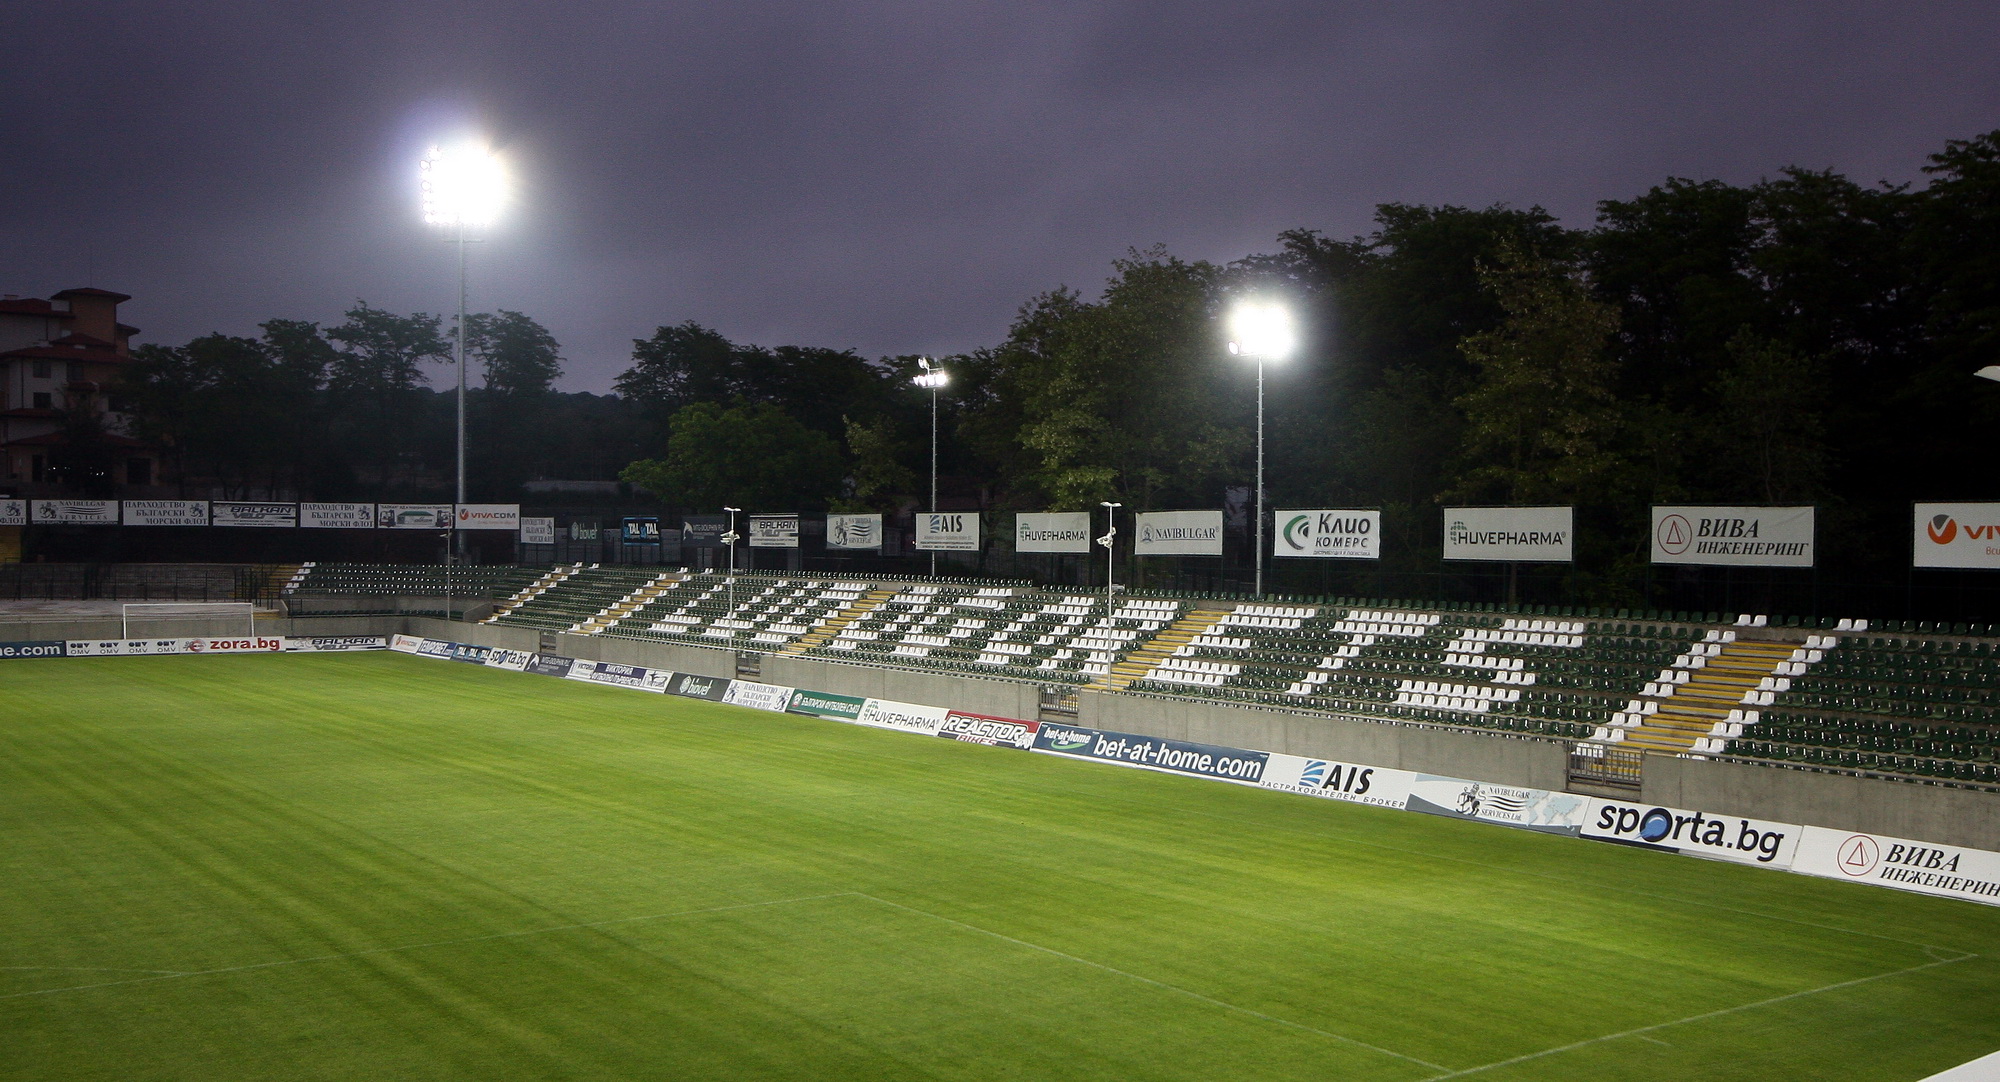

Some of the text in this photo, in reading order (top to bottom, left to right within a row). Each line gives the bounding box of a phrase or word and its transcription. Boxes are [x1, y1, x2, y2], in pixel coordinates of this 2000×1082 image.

[302, 503, 355, 511] ПАРАХОДСТВО
[311, 511, 354, 519] БЪЛГАРСКИ
[759, 521, 796, 529] BALKAN
[941, 515, 963, 533] AIS
[1317, 513, 1371, 534] Клио
[1697, 518, 1759, 538] ВИВА
[1963, 525, 2000, 540] VI
[1024, 530, 1085, 541] HUVEPHARMA
[1155, 527, 1216, 540] NAVIBULGAR
[1315, 537, 1369, 548] КОМЕРС
[1458, 531, 1563, 545] HUVEPHARMA
[1696, 541, 1809, 556] ИНЖЕНЕРИНГ
[209, 637, 280, 652] zora.bg
[490, 649, 527, 668] sporta.bg
[687, 677, 713, 696] biovet
[868, 709, 936, 731] HUVEPHARMA
[940, 715, 1026, 742] REACTOR
[956, 735, 998, 746] BIKES
[1044, 726, 1092, 744] bet-at-home
[1093, 735, 1262, 780] bet-at-home.com
[1322, 764, 1375, 795] AIS
[1260, 780, 1406, 809] ЗАСТРАХОВАТЕЛЕН БРОКЕР
[1488, 786, 1531, 799] NAVIBULGAR
[1481, 809, 1510, 820] SERVICES
[1596, 804, 1785, 862] sporta.bg
[1885, 843, 1961, 872] ВИВА
[1878, 866, 2000, 898] ИНЖЕНЕРИН
